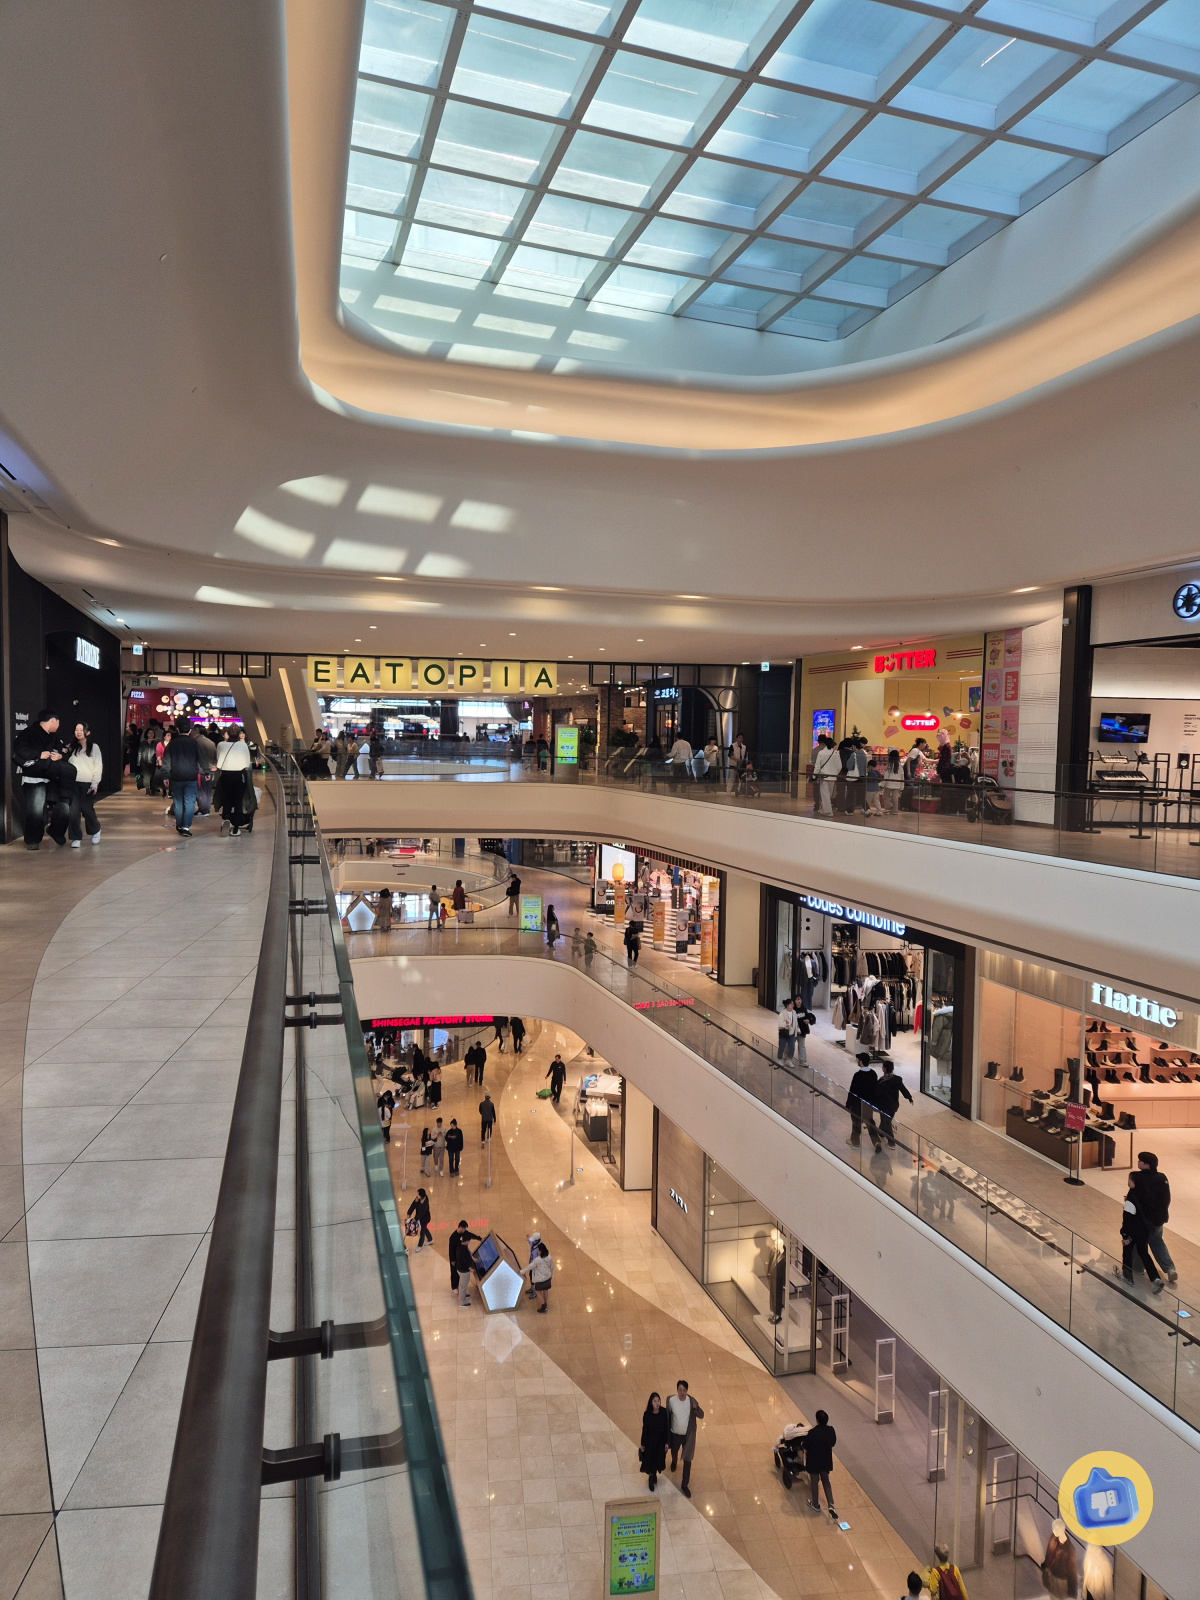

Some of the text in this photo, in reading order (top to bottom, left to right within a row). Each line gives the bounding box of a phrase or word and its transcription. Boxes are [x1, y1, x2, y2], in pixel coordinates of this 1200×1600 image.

[874, 649, 936, 673] BUTTER
[314, 660, 553, 688] EATOPIA
[131, 691, 144, 699] PIZZA
[1092, 982, 1177, 1028] flattie
[371, 1015, 494, 1028] SHINSEGAE FACTORY STORE
